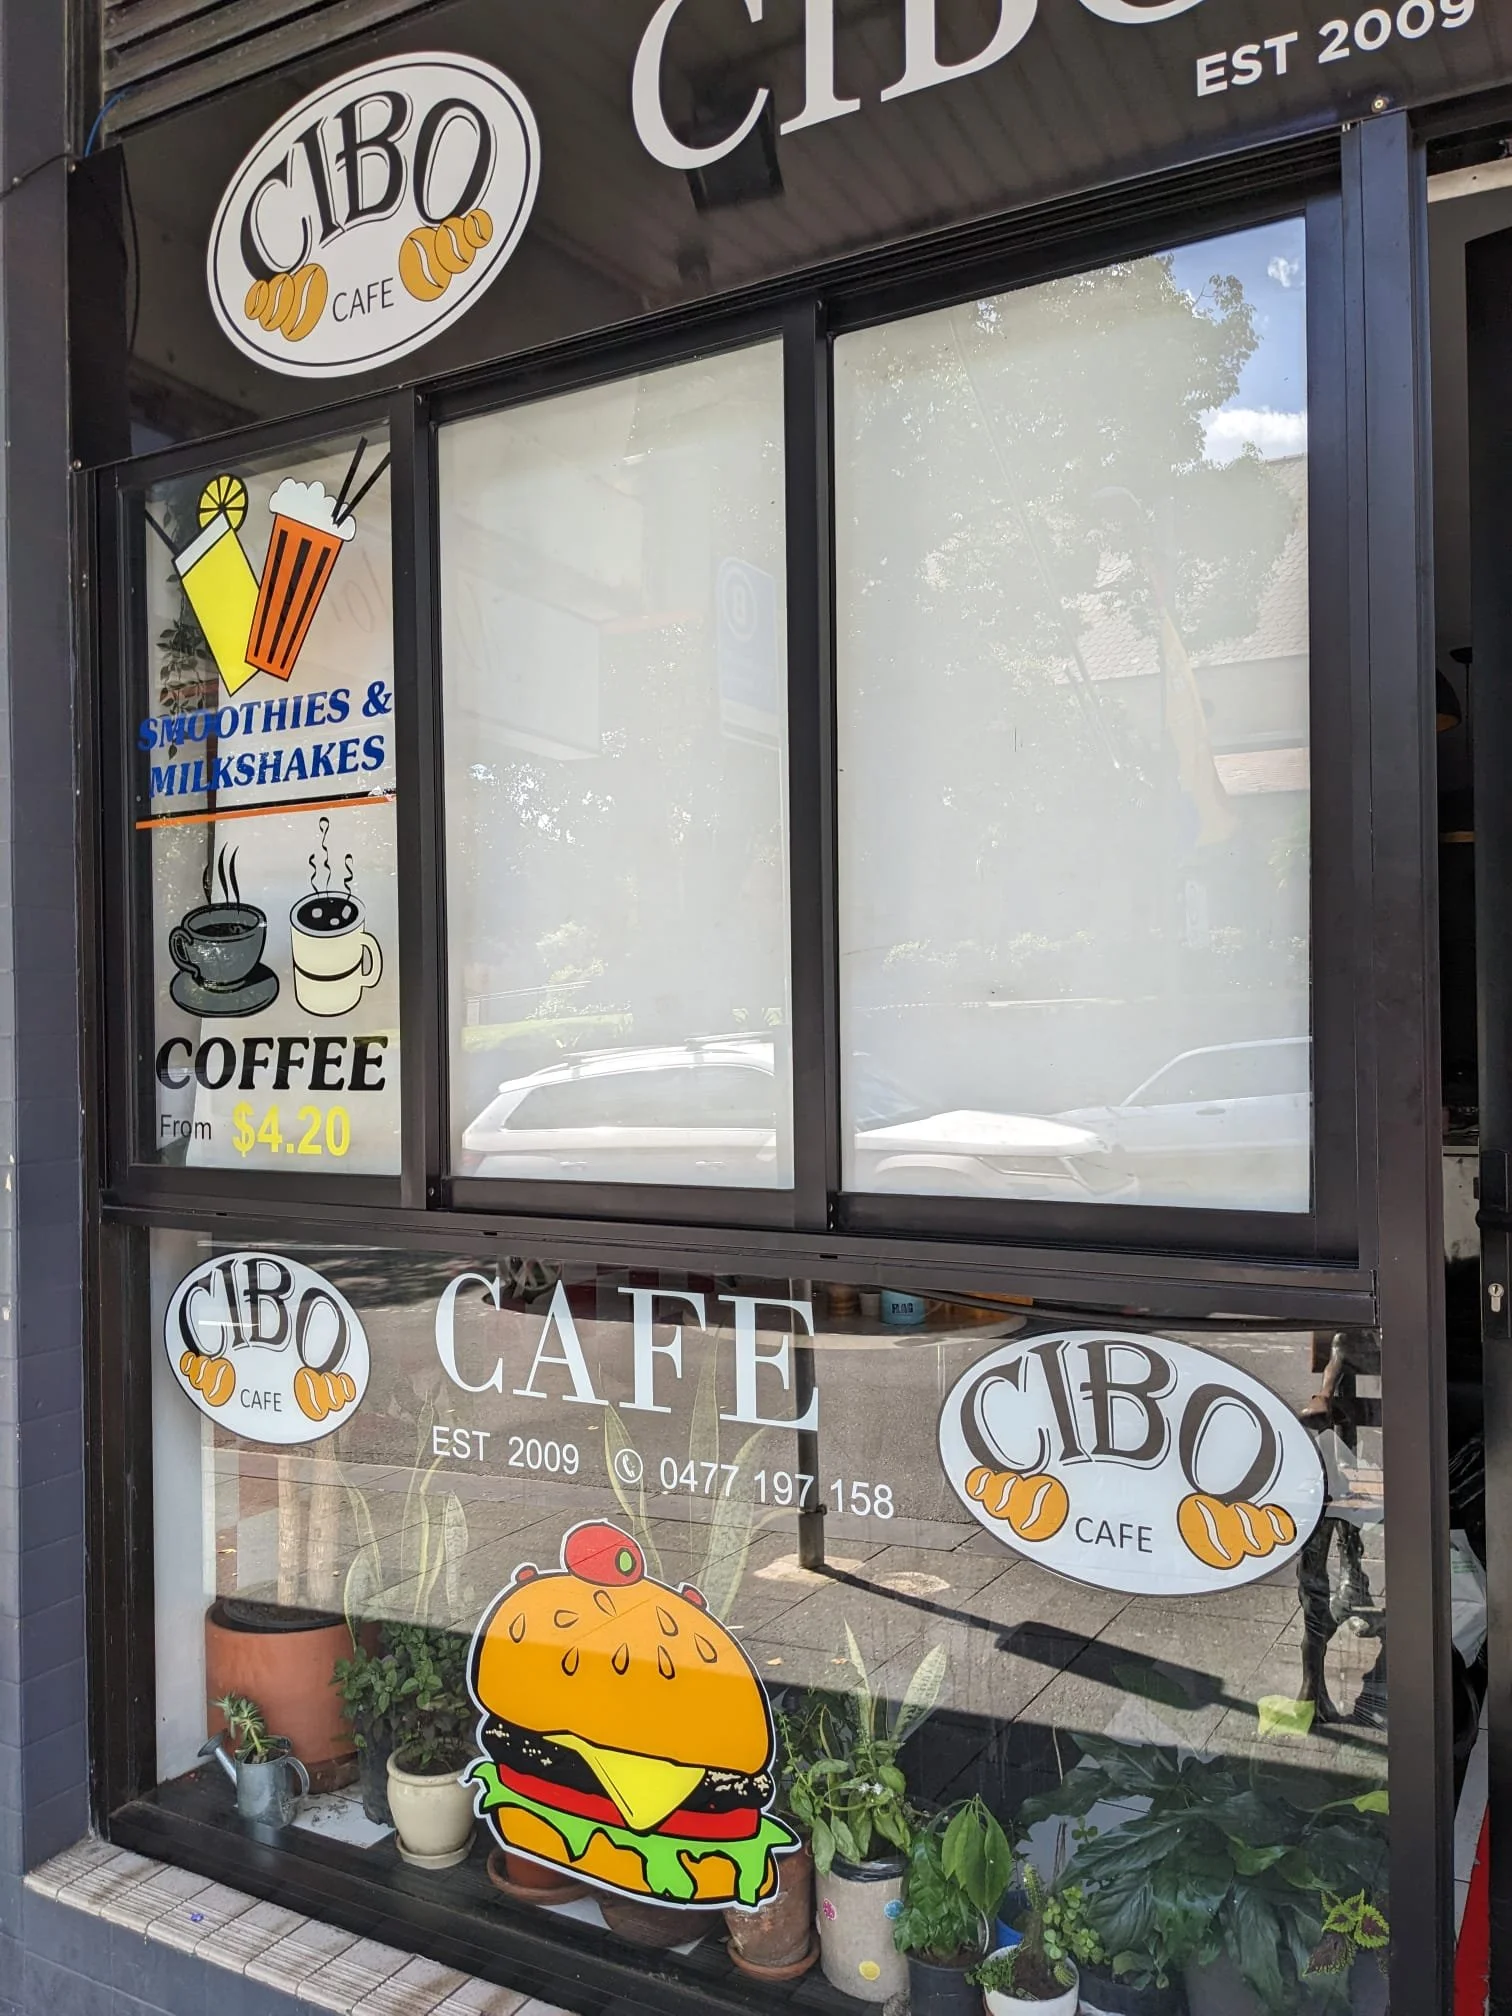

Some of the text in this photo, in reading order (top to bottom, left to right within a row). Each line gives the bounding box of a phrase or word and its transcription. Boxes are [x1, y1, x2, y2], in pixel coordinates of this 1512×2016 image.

[1196, 0, 1475, 97] EST 2009
[240, 90, 498, 280] CIBO
[332, 278, 395, 323] CAFE
[137, 680, 392, 750] SMOOTHIES &
[149, 734, 386, 799] MILKSHAKES
[156, 1036, 388, 1091] COFFEE
[160, 1101, 351, 1157] From $4.20
[178, 1257, 350, 1374] CIBO
[434, 1272, 819, 1432] CAFE
[240, 1388, 282, 1412] CAFE
[959, 1339, 1283, 1503] CIBO
[432, 1425, 580, 1475] EST 2009
[660, 1456, 894, 1520] 0477 197 158
[1074, 1516, 1153, 1554] CAFE
